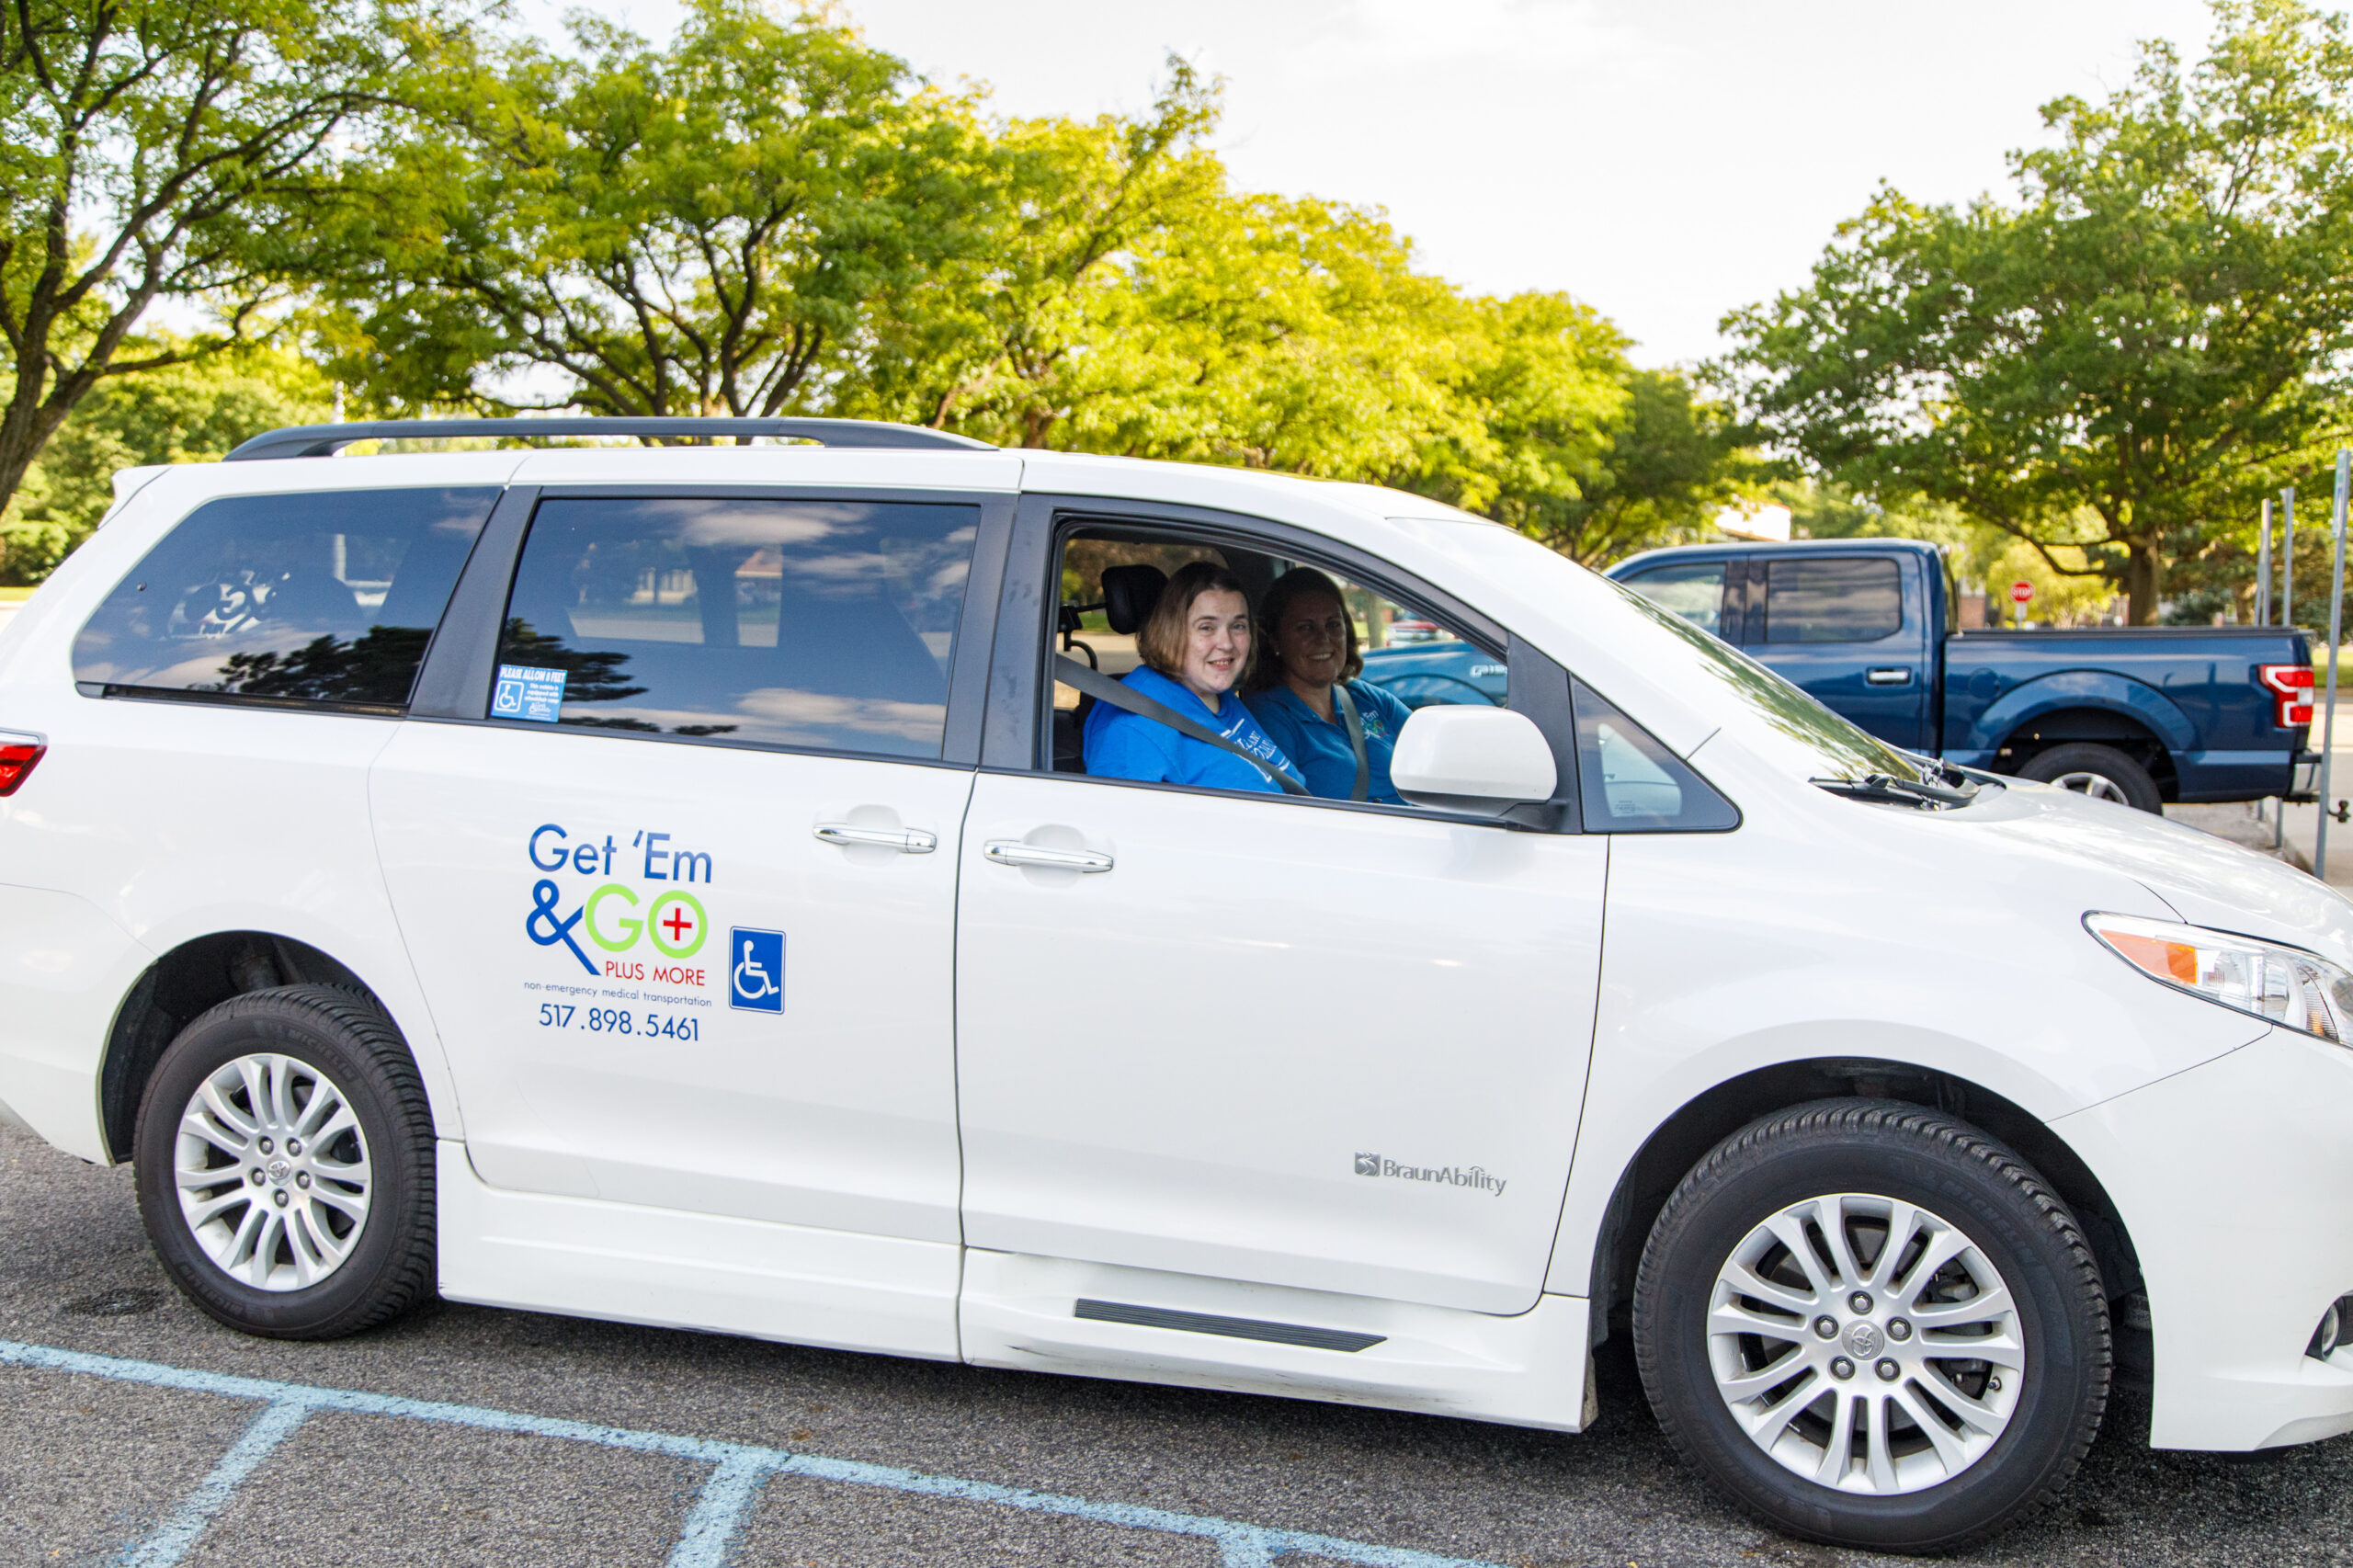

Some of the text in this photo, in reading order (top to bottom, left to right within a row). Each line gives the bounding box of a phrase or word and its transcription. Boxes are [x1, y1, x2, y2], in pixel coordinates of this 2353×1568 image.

[2012, 586, 2033, 597] STOP
[500, 666, 523, 679] PLEASE
[523, 669, 546, 681] ALLOW
[551, 672, 566, 683] FEET
[529, 824, 712, 883] Get 'Em
[606, 960, 706, 986] PLUS MORE
[602, 987, 639, 1000] medical
[643, 991, 712, 1007] transportation
[1383, 1159, 1506, 1197] BraunAbility
